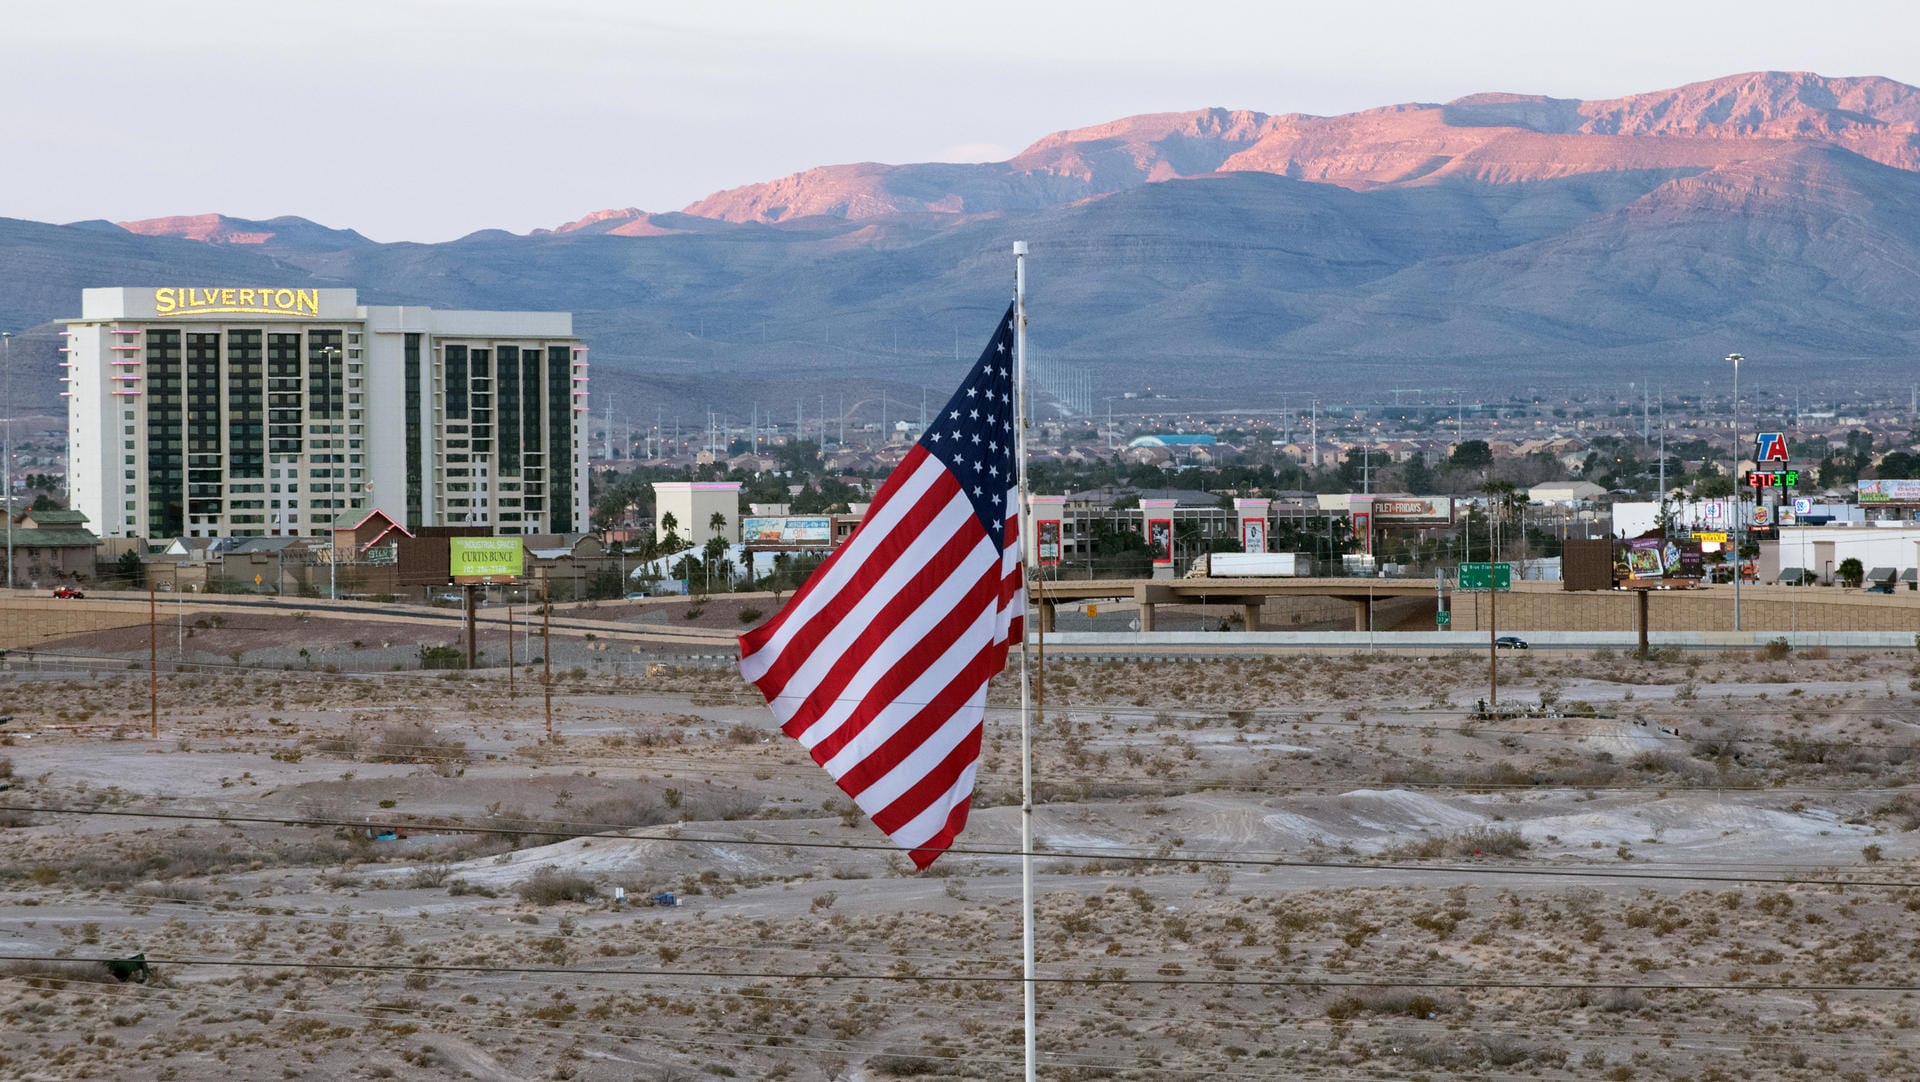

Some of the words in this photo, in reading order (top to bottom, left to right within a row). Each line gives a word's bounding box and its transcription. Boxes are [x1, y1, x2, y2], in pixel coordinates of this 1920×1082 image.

[155, 287, 319, 314] SILVERTON
[1757, 432, 1789, 461] TA
[1375, 502, 1393, 513] FILET
[1395, 502, 1422, 513] FRIDAYS
[462, 552, 488, 562] CURTIS
[489, 552, 513, 562] BUNCE
